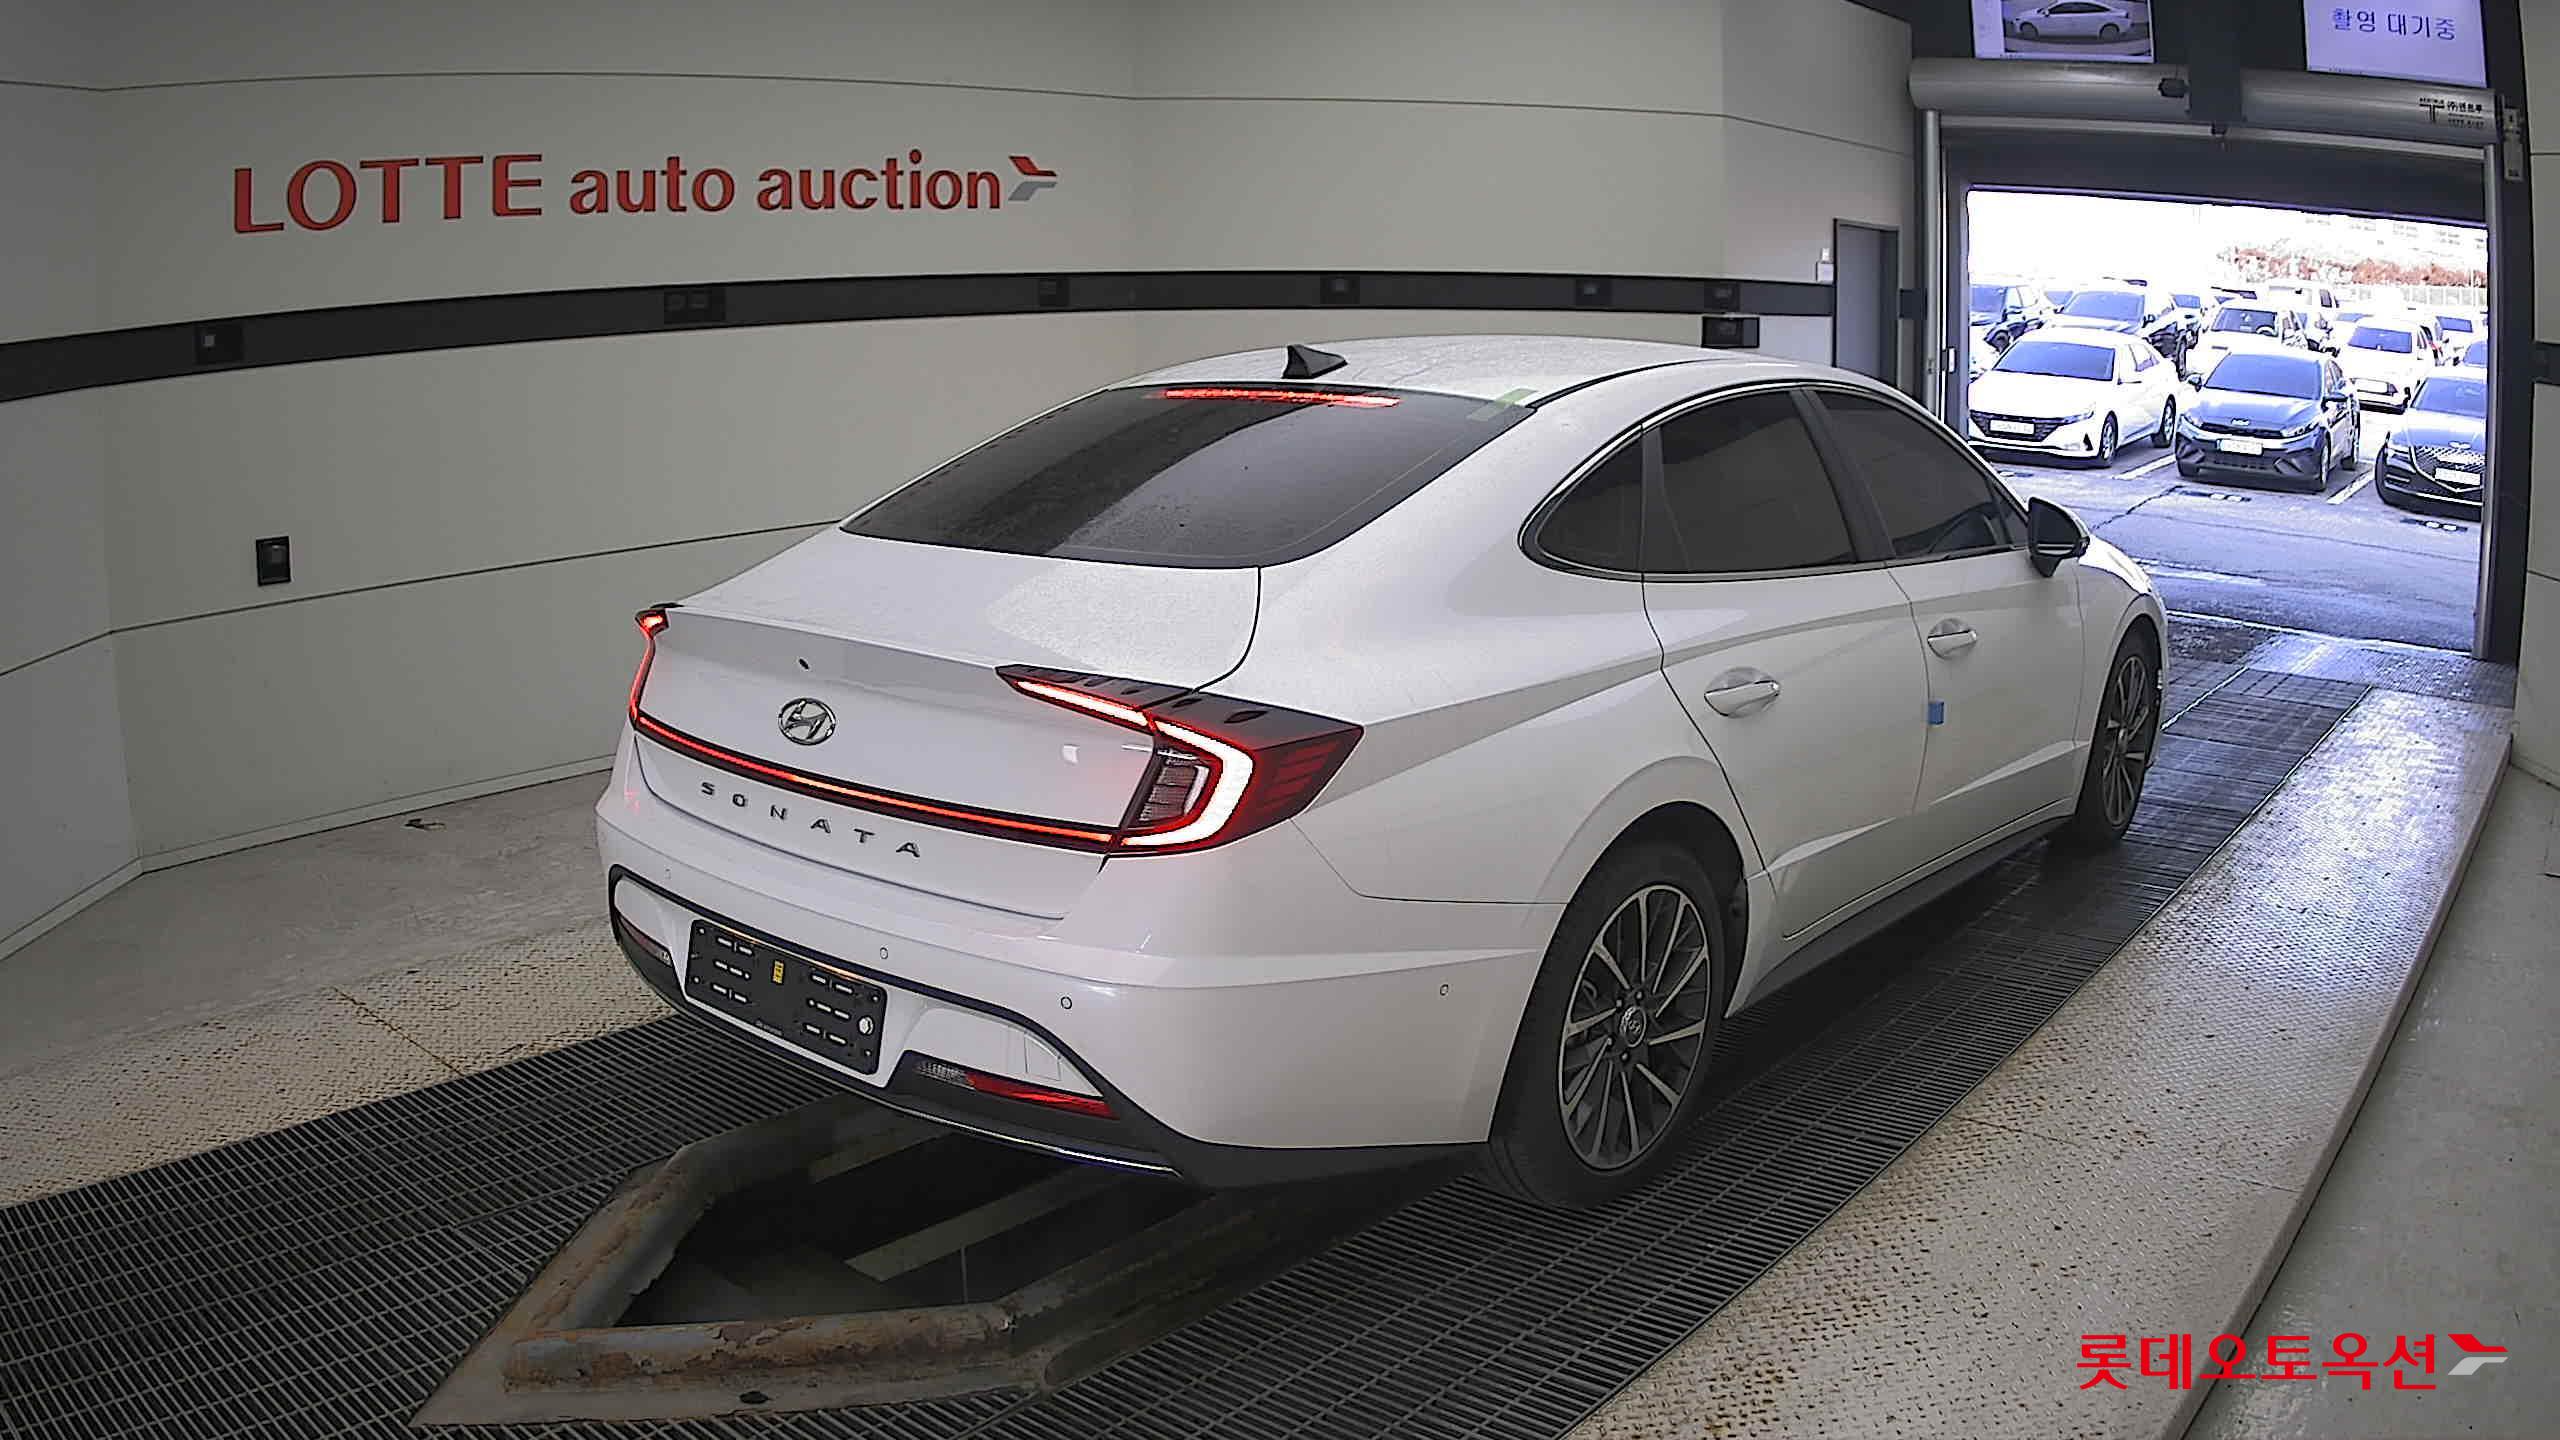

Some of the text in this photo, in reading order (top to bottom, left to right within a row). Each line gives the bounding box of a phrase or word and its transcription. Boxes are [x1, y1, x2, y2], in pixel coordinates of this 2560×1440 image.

[2333, 8, 2456, 41] 촬영 대기중
[234, 148, 1001, 233] LOTTE auto auction
[700, 781, 921, 858] SONATA
